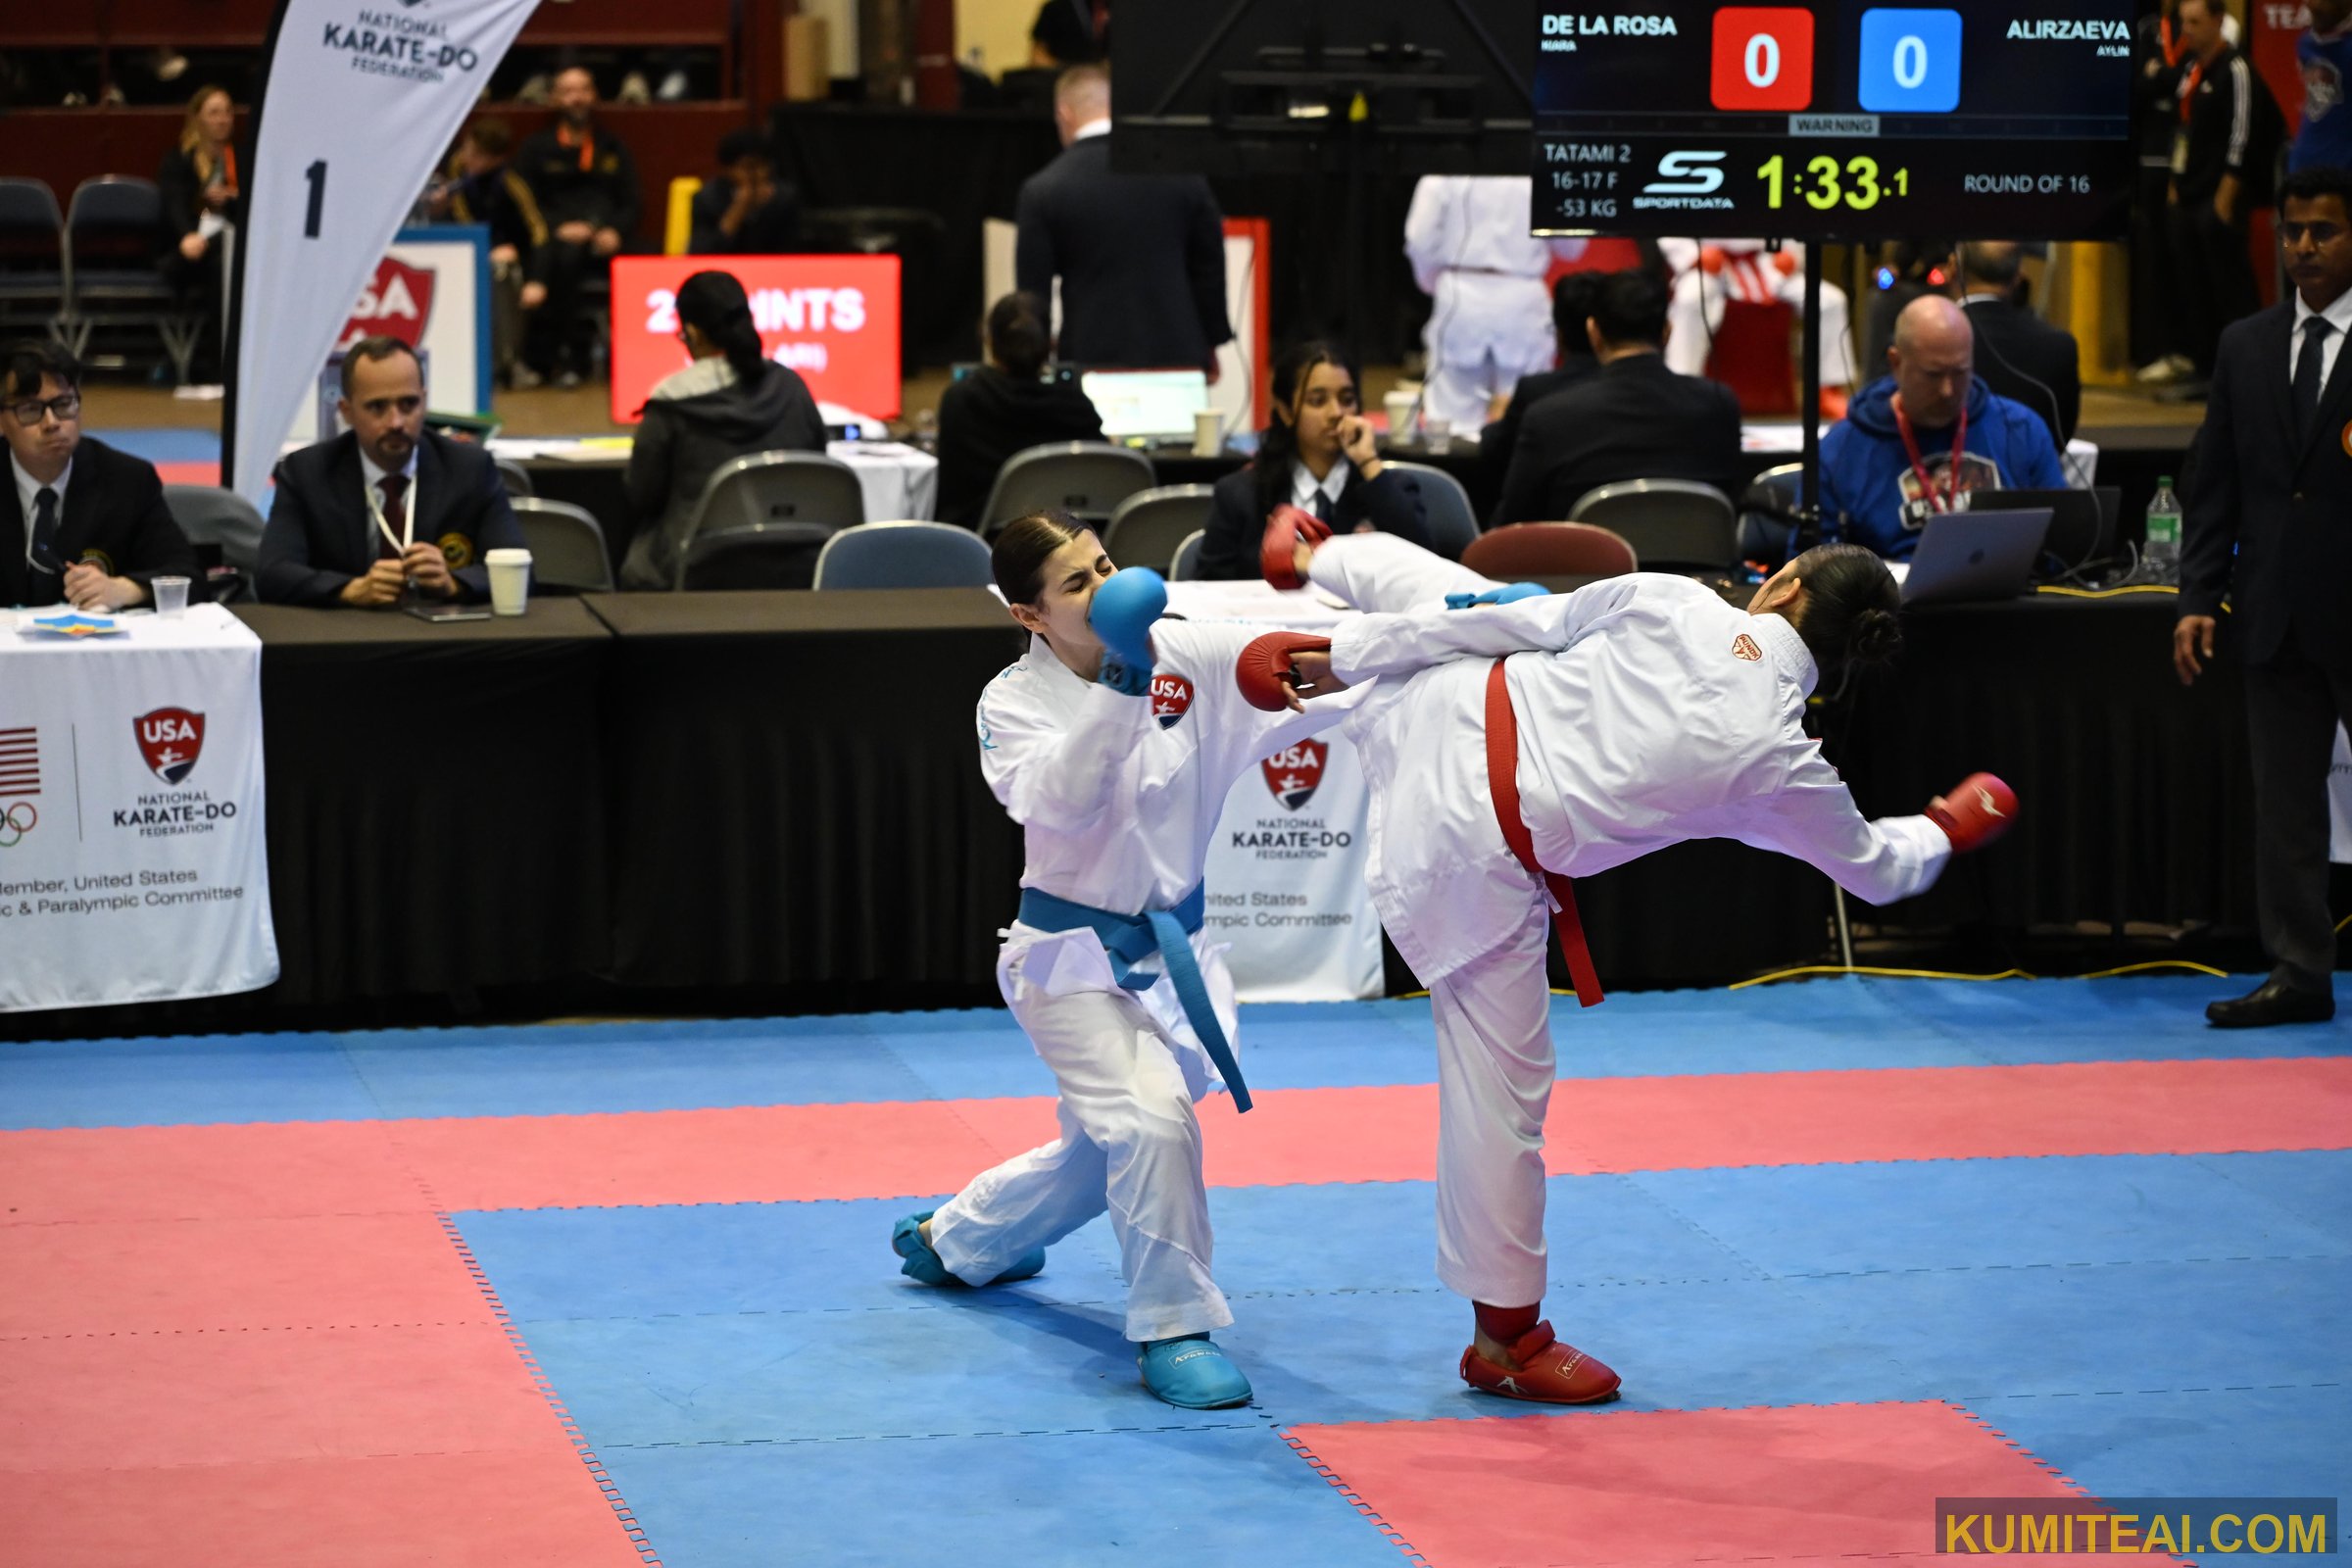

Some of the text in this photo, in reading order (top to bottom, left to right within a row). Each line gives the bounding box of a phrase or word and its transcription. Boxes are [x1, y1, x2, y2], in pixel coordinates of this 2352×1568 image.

[359, 10, 446, 36] NATIONAL
[1543, 15, 1678, 35] DE LA ROSA
[2264, 3, 2312, 29] TEA
[2006, 19, 2131, 40] ALIRZAEVA
[322, 22, 477, 72] KARATE-DO
[352, 56, 445, 82] FEDERATION
[1743, 33, 1780, 87] 0
[1892, 35, 1928, 89] 0
[1796, 119, 1873, 133] WARNING
[1544, 144, 1631, 163] TATAMI 2
[1552, 171, 1618, 189] 16-17 F
[1964, 174, 2090, 194] ROUND OF 16
[304, 159, 328, 239] 1
[1555, 198, 1617, 218] -53 KG
[1633, 197, 1735, 209] SPORTDATA
[351, 273, 418, 319] SA
[646, 288, 677, 333] 2
[1151, 678, 1187, 701] USA
[143, 718, 197, 743] USA
[1268, 746, 1319, 769] USA
[138, 791, 211, 806] NATIONAL
[113, 801, 236, 827] KARATE-DO
[1256, 818, 1326, 829] NATIONAL
[139, 823, 214, 837] FEDERATION
[1232, 831, 1351, 848] KARATE-DO
[1255, 850, 1328, 859] FEDERATION
[0, 869, 198, 896] ember, United States
[19, 900, 32, 916] &
[37, 894, 139, 915] Paralympic
[145, 886, 244, 906] Committee
[1205, 892, 1307, 906] nited States
[1254, 912, 1352, 928] Committee
